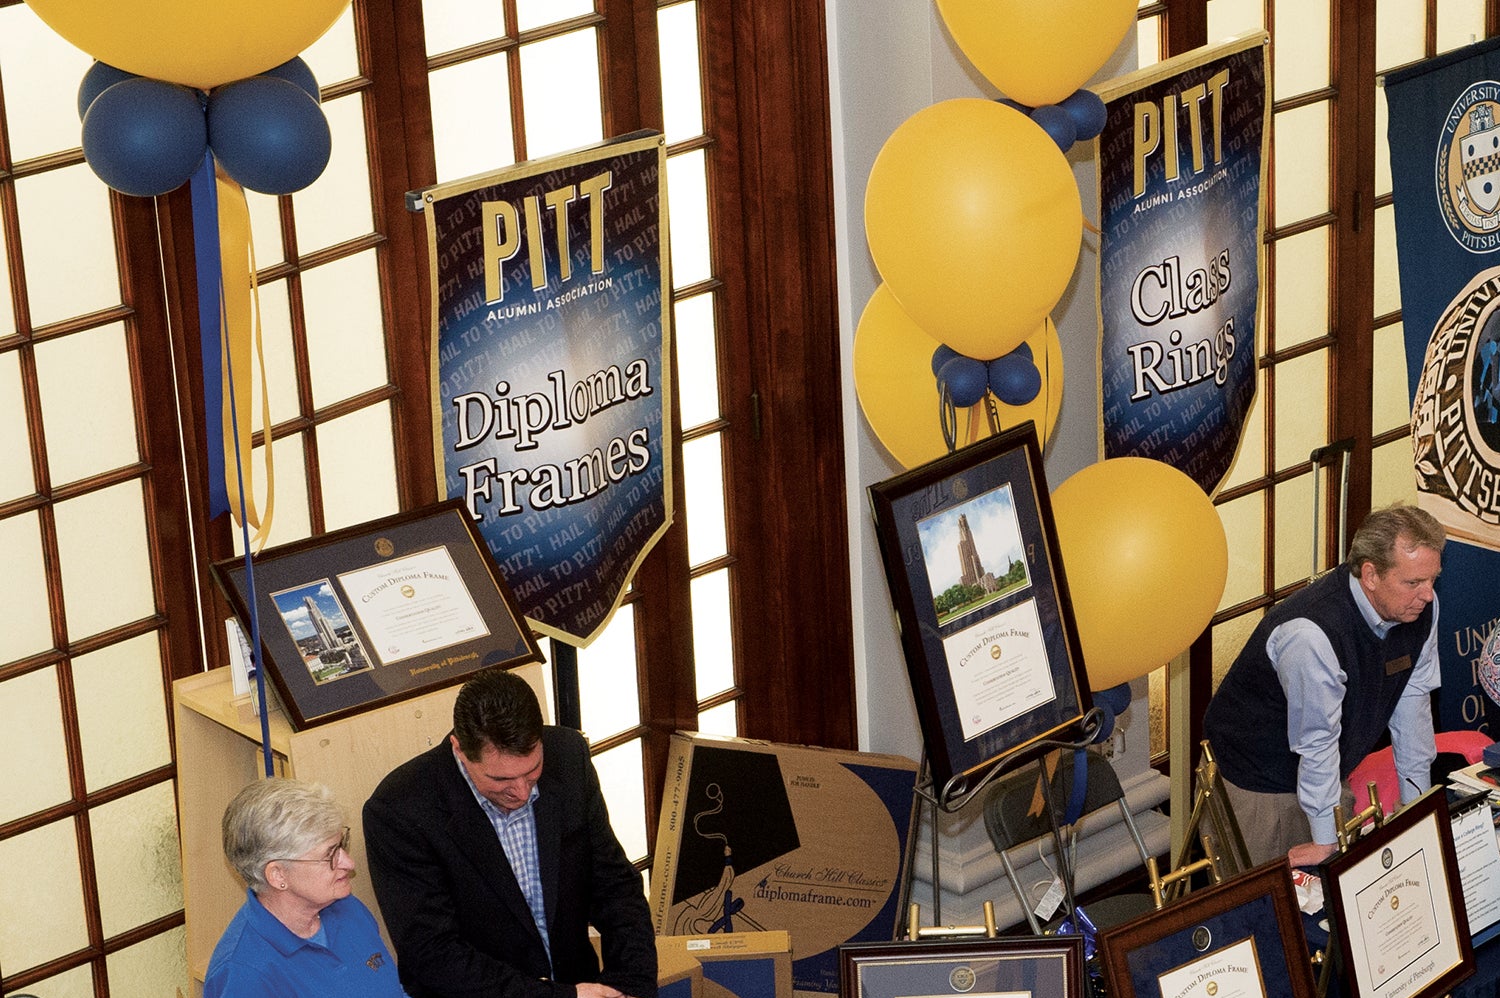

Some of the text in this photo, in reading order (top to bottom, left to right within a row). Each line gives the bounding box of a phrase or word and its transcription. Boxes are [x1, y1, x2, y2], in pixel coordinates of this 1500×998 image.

[1446, 86, 1500, 134] UNIVERSITY
[1133, 68, 1230, 199] PITT
[1133, 169, 1228, 214] ALUMNI ASSOCIATION
[482, 171, 612, 306] PITT
[486, 278, 613, 321] ALUMNI ASSOCIATION
[1130, 248, 1231, 326] Class
[1127, 317, 1236, 402] Rings
[453, 358, 653, 451] Diploma
[458, 427, 650, 521] Frames
[361, 571, 449, 604] CUSTOM DIPLOMA FRAME
[959, 627, 1031, 668] CUSTOM DIPLOMA FRAME
[756, 885, 872, 909] diplomaframe.com
[774, 863, 887, 888] Church Hill Classics
[1197, 967, 1227, 984] DIPLOMA
[1227, 964, 1249, 975] FRAME
[1407, 976, 1413, 988] of
[1413, 960, 1436, 983] Pittsburgh
